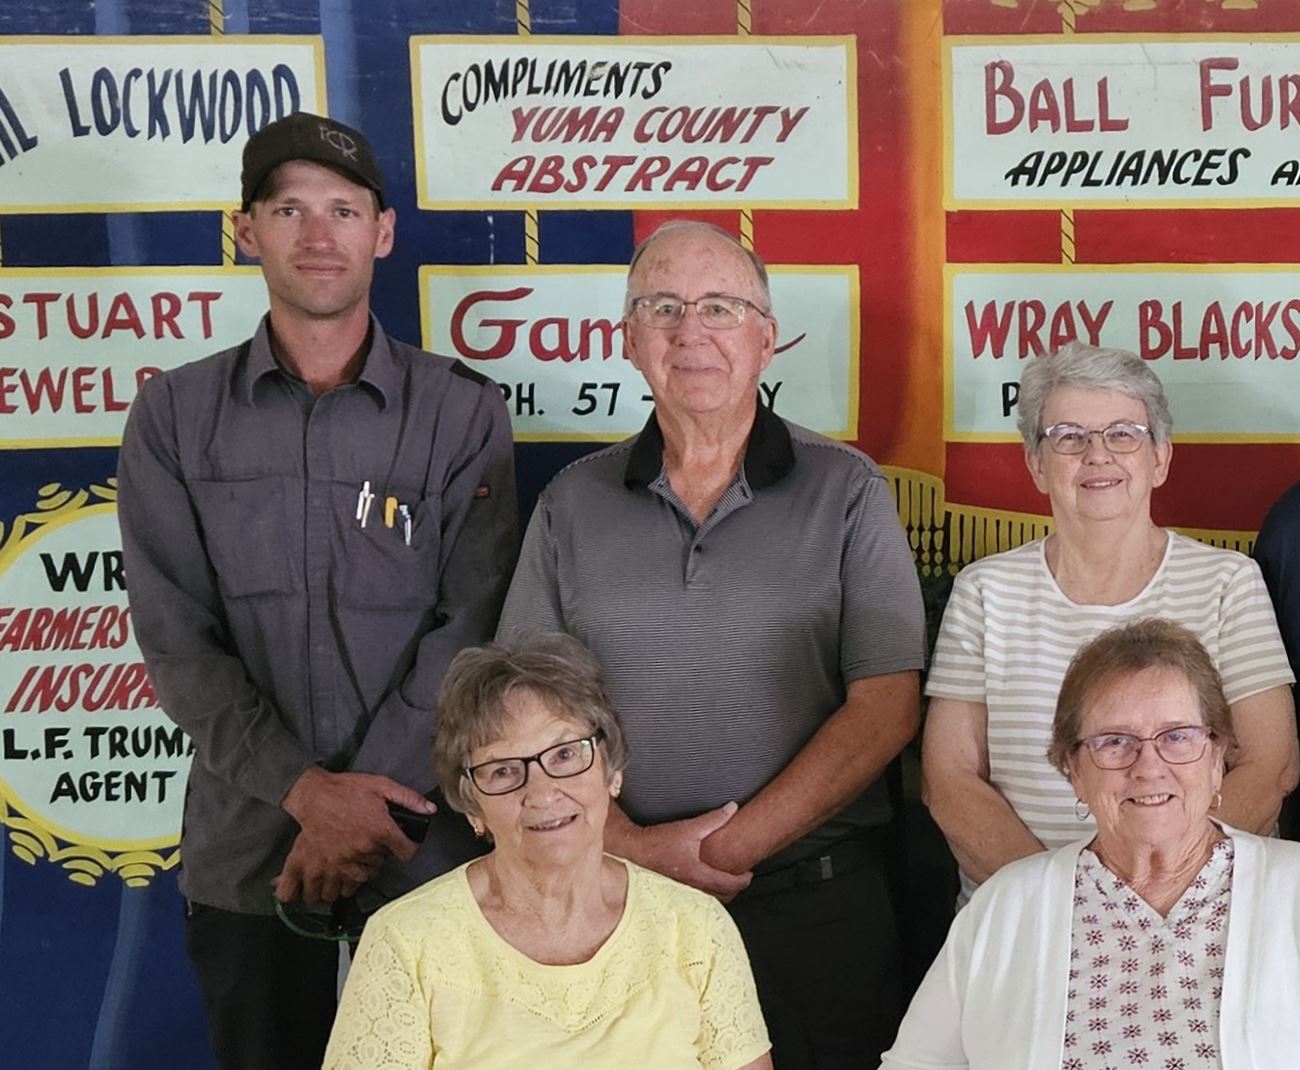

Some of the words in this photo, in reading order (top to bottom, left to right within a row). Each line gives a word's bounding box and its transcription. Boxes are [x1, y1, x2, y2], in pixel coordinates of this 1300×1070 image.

[59, 64, 300, 144] LOCKWOOD
[441, 57, 672, 125] COMPLIMENTS
[511, 106, 625, 143] YUMA
[633, 105, 809, 143] COUNTY
[491, 155, 774, 193] ABSTRACT
[1004, 148, 1251, 187] APPLIANCES
[965, 299, 1114, 359] WRAY
[5, 663, 160, 713] INSURA
[83, 726, 195, 760] TRUM
[50, 771, 177, 803] AGENT
